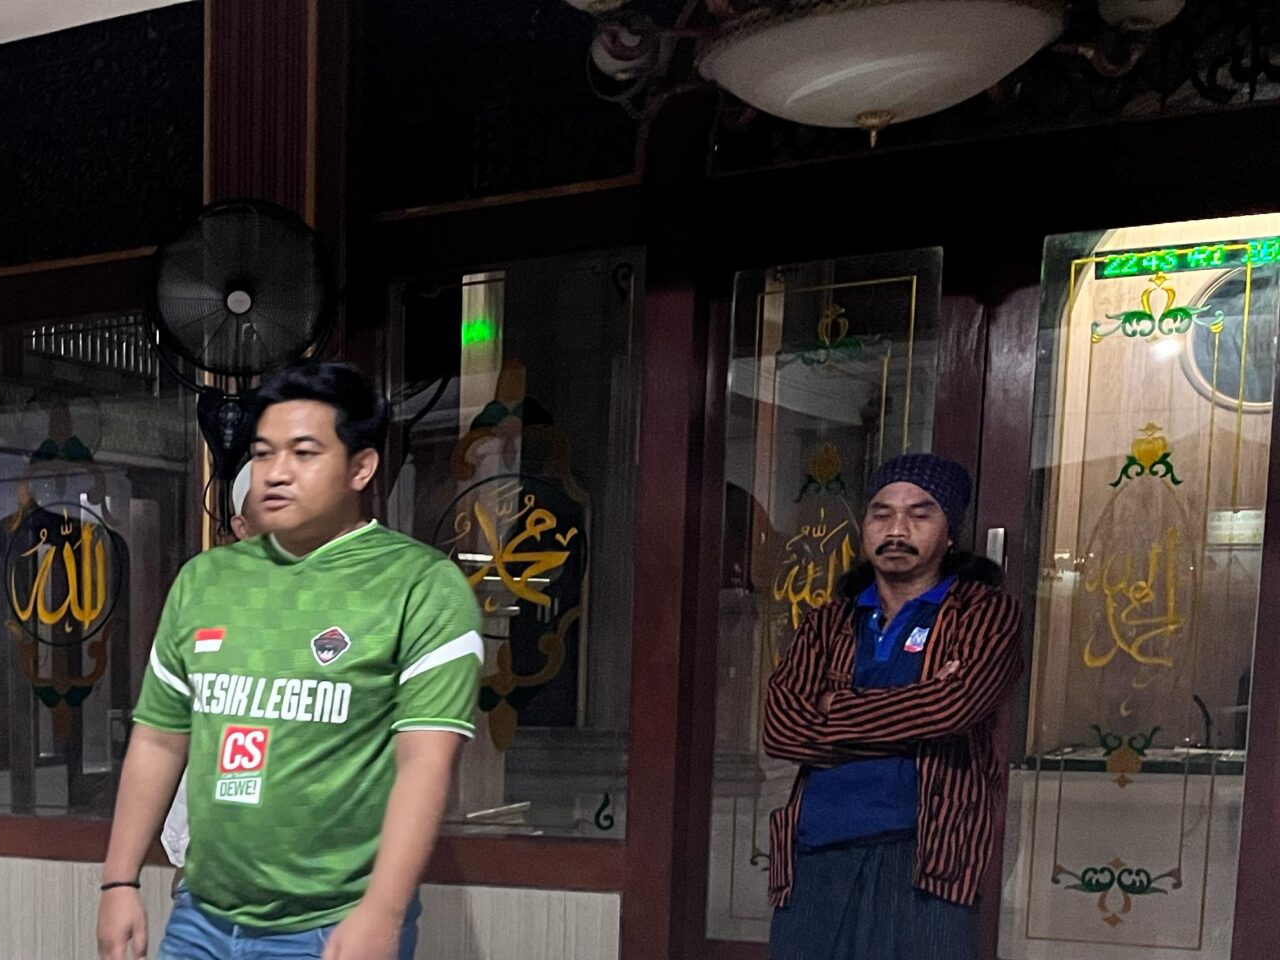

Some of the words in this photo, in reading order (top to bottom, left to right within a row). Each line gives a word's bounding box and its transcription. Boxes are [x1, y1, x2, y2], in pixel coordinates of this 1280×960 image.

[250, 678, 352, 724] LEGEND
[222, 731, 264, 770] CS
[220, 779, 257, 797] DEWE!
